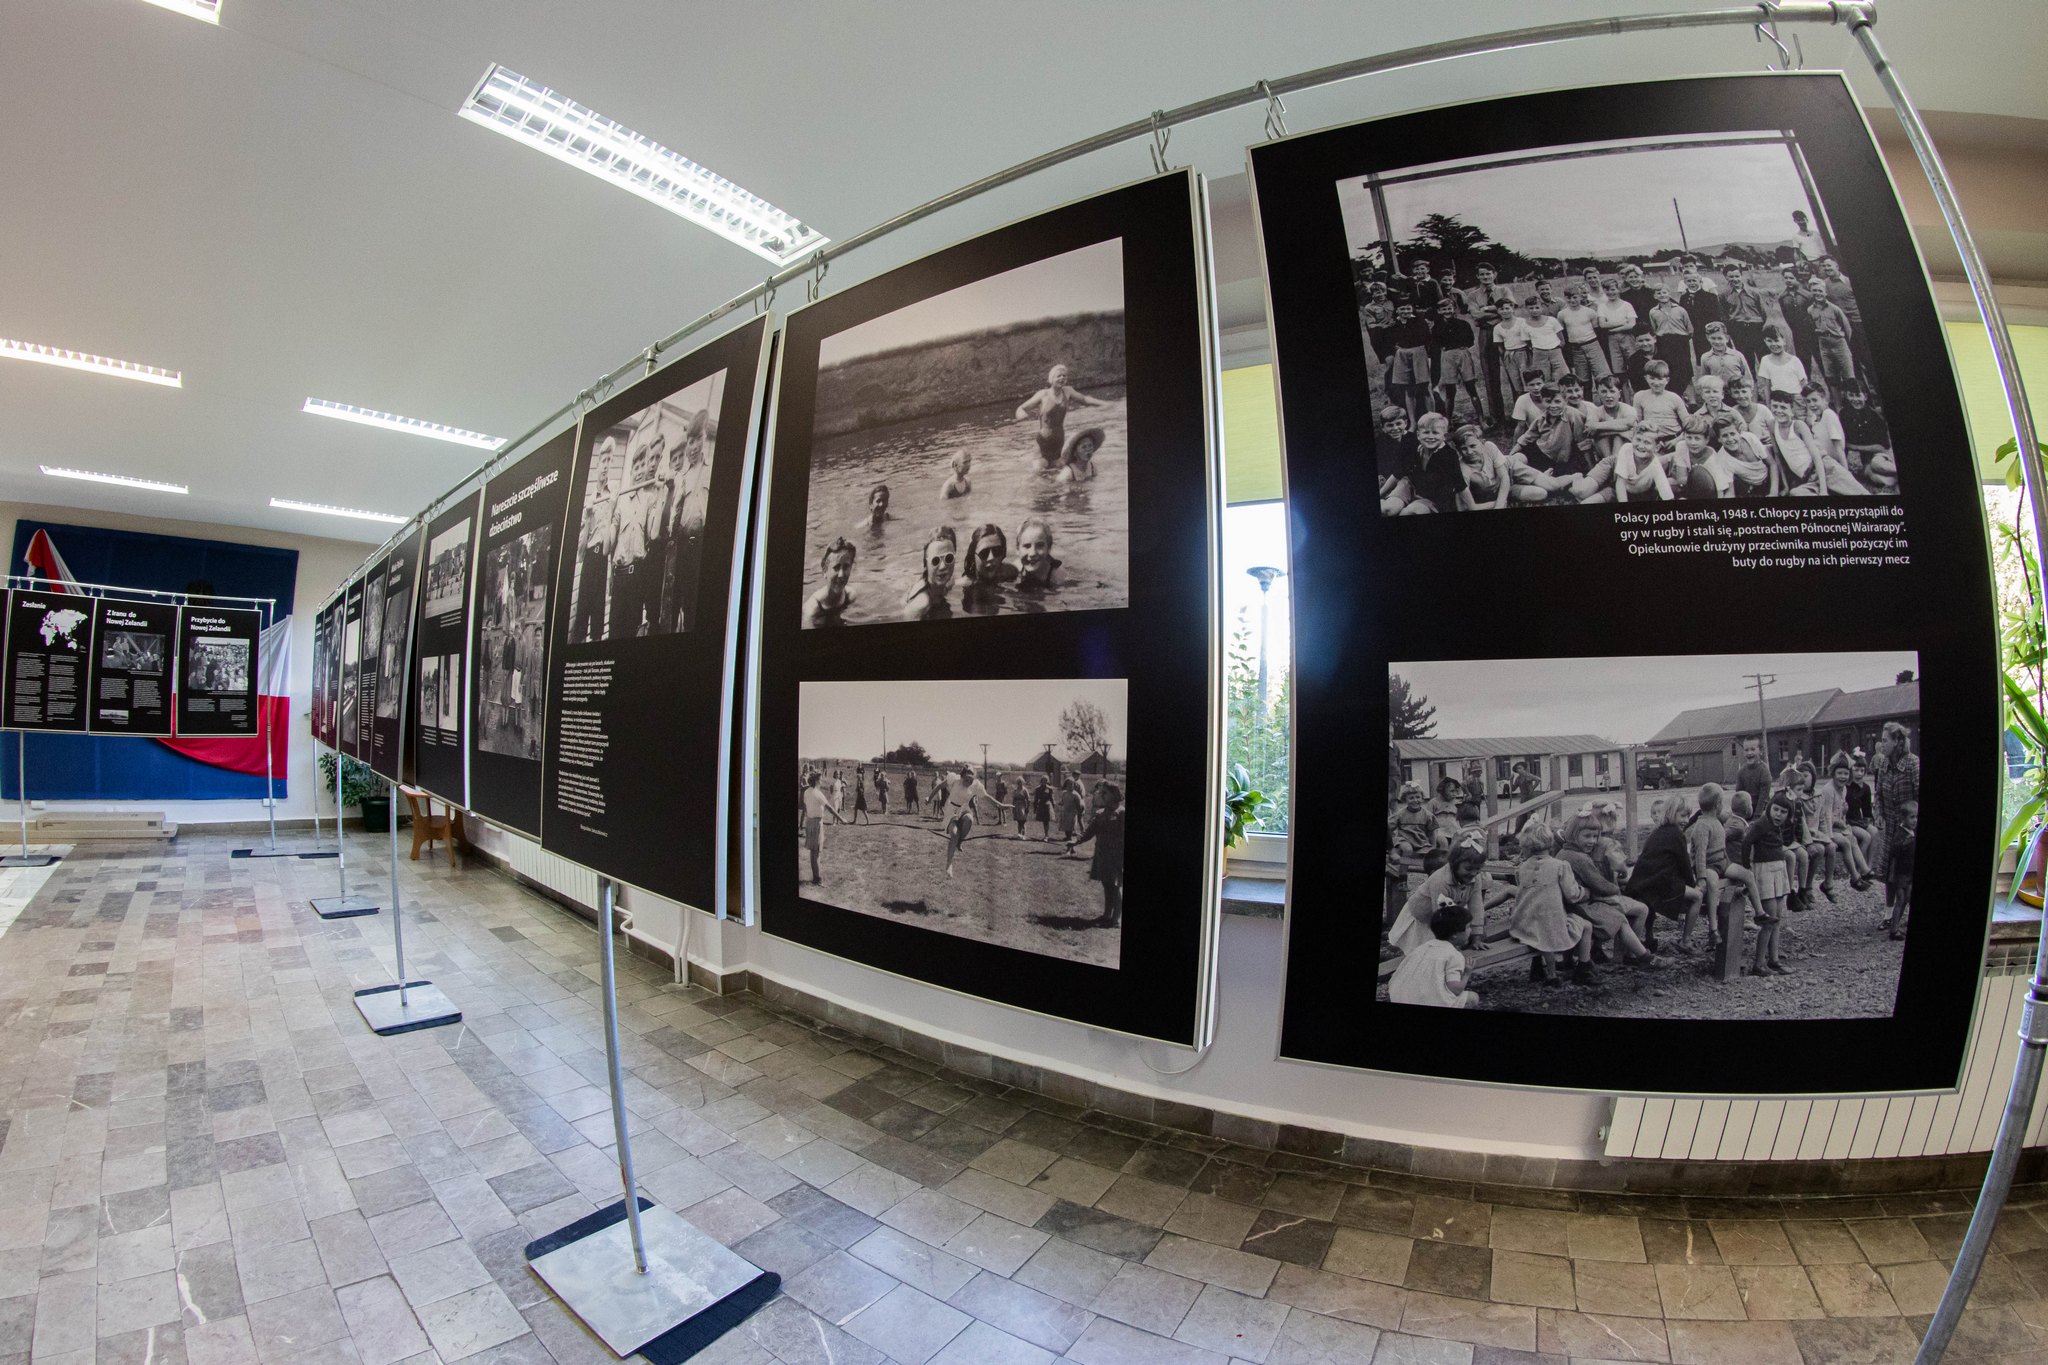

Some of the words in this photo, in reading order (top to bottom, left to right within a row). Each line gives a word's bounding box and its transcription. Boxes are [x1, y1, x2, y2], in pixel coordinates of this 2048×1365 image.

[491, 492, 518, 518] Nareszcie
[517, 470, 559, 499] szczęśliwsze
[1614, 512, 1650, 525] Polacy
[1652, 511, 1674, 524] pod
[1676, 509, 1720, 522] bramką,
[1722, 508, 1748, 520] 1948
[1749, 510, 1757, 519] r.
[1758, 507, 1800, 520] Chłopcy
[1801, 509, 1809, 518] z
[1810, 506, 1837, 520] pasją
[1839, 505, 1889, 519] przystąpili
[1890, 505, 1904, 516] do
[489, 511, 522, 537] dzieciństwo
[1620, 529, 1638, 542] gry
[1641, 530, 1651, 538] w
[1653, 526, 1685, 540] rugby
[1687, 526, 1691, 537] i
[1693, 525, 1715, 536] stali
[1717, 525, 1732, 538] się
[1733, 523, 1799, 537] „postrachem
[1800, 522, 1851, 535] Północnej
[1628, 541, 1701, 556] Opiekunowie
[1702, 541, 1746, 554] drużyny
[1748, 539, 1810, 553] przeciwnika
[1811, 538, 1848, 550] musieli
[1849, 537, 1894, 551] pożyczyć
[1895, 538, 1908, 549] im
[1732, 556, 1757, 570] buty
[1759, 556, 1773, 567] do
[1775, 555, 1805, 569] rugby
[1807, 556, 1821, 566] na
[1822, 554, 1838, 566] ich
[1839, 554, 1883, 568] pierwszy
[1884, 555, 1911, 565] mecz
[105, 617, 124, 627] Nowej
[124, 618, 149, 628] Zelandii
[106, 609, 113, 617] Z
[128, 611, 137, 619] do
[190, 616, 217, 625] Przybycie
[217, 617, 226, 625] do
[190, 624, 208, 634] Nowej
[208, 625, 231, 633] Zelandii
